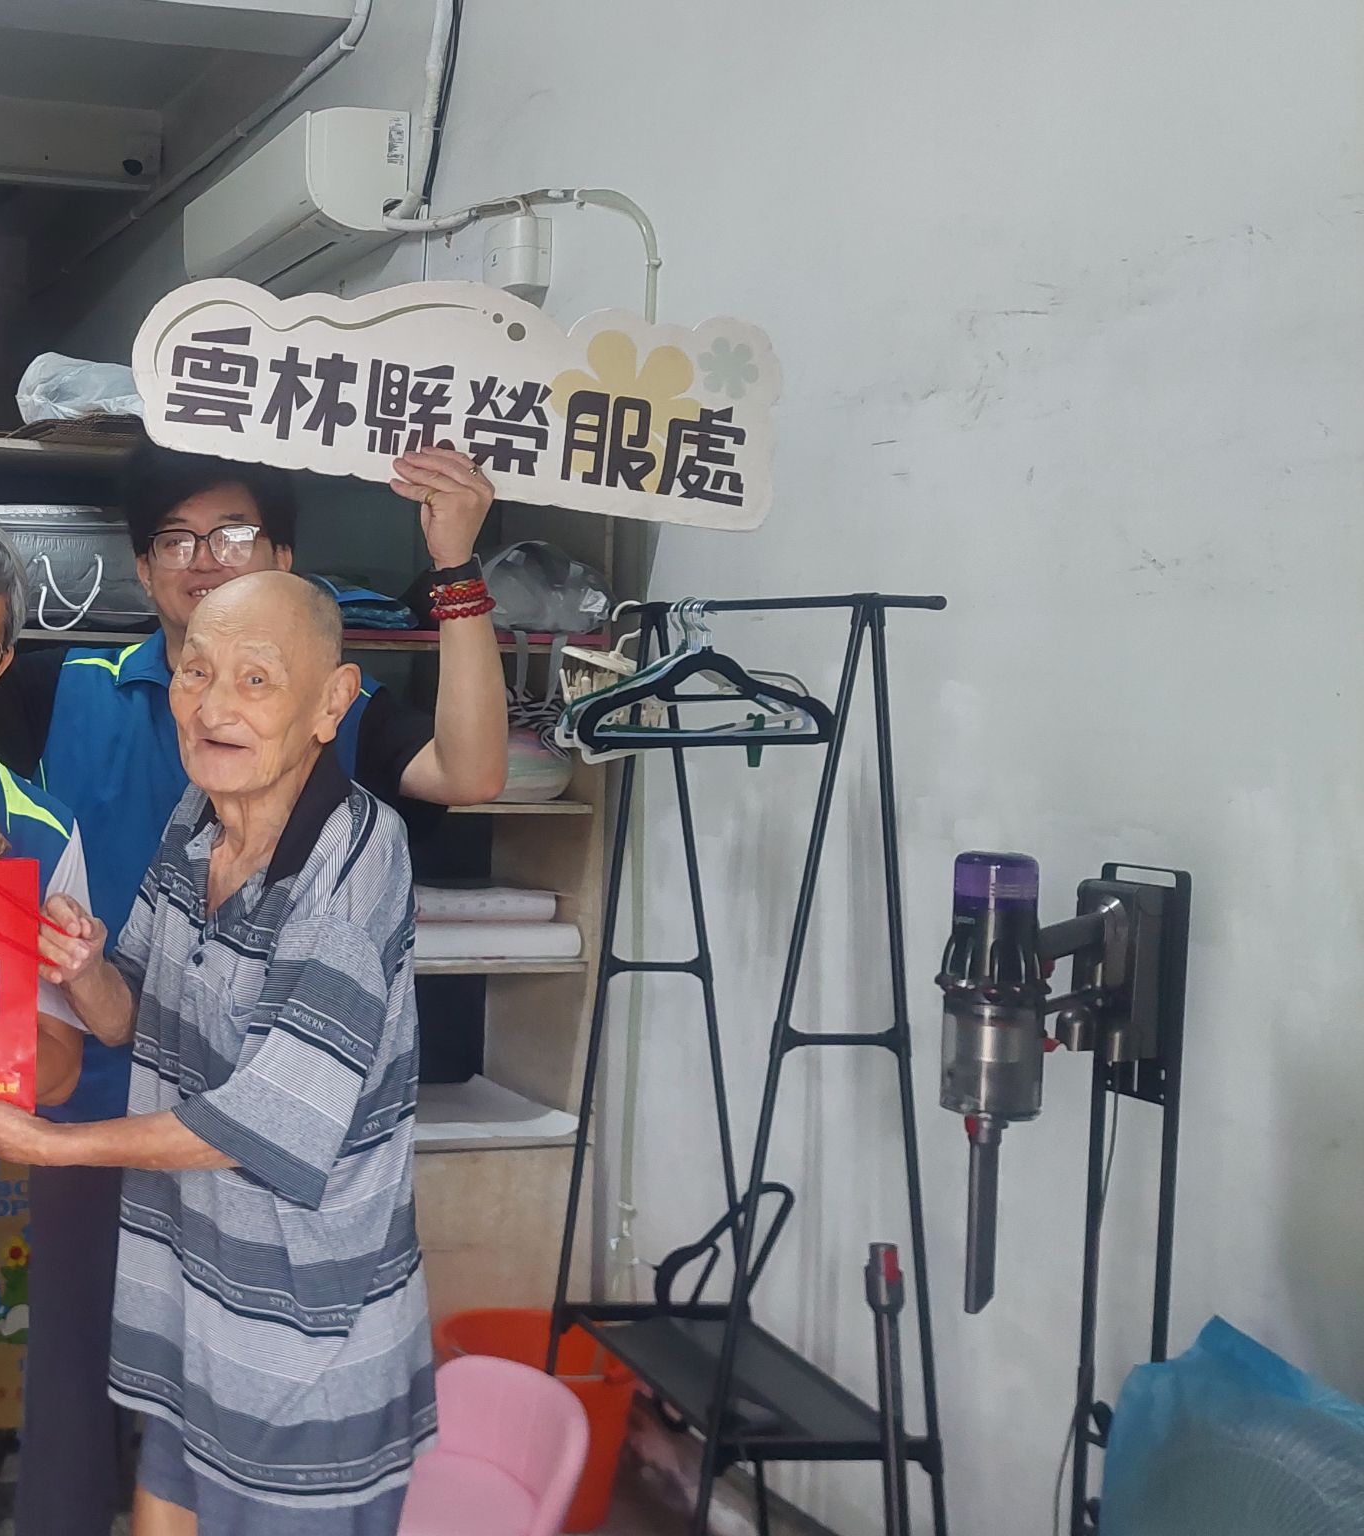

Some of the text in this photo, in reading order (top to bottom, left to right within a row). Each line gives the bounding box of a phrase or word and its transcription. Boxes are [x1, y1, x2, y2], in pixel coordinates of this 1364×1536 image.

[163, 325, 748, 507] 雲林縣榮服處
